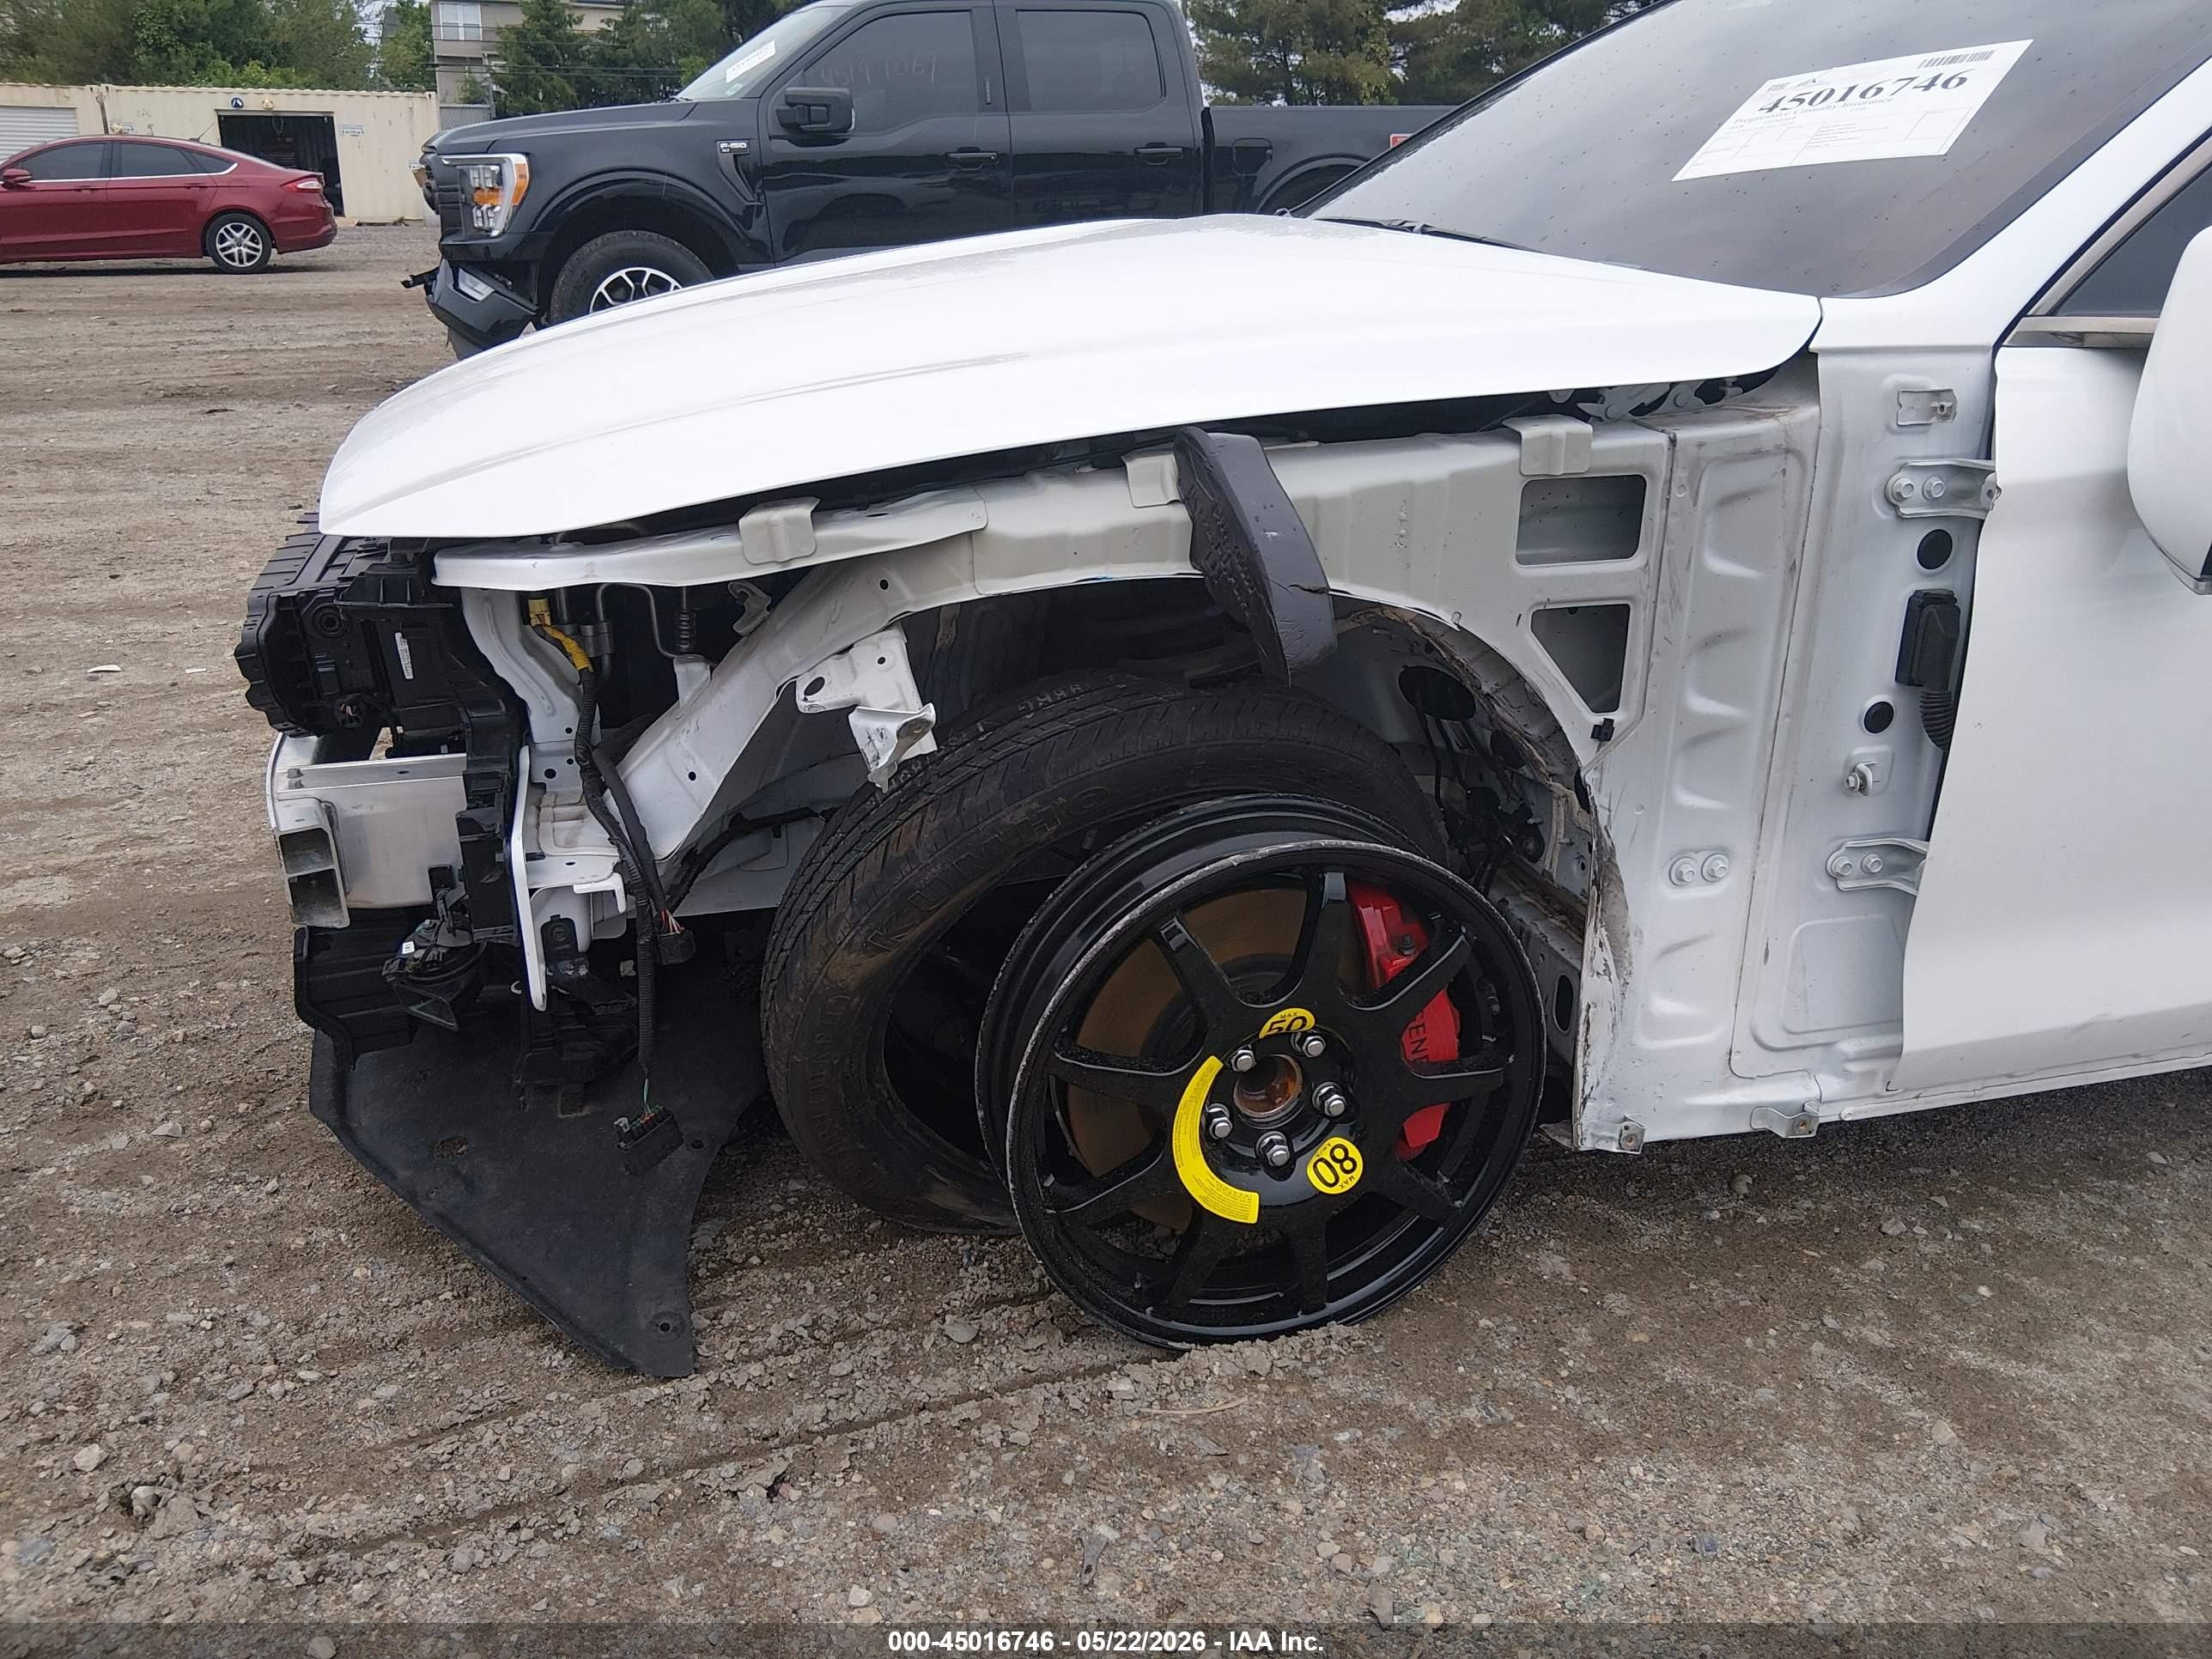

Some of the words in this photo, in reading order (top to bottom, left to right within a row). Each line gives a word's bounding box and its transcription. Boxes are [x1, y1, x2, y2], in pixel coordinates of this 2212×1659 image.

[1758, 69, 1976, 114] 45016746
[1279, 1011, 1298, 1019] MAX
[1312, 1143, 1358, 1188] 80
[1338, 1175, 1356, 1189] MAX
